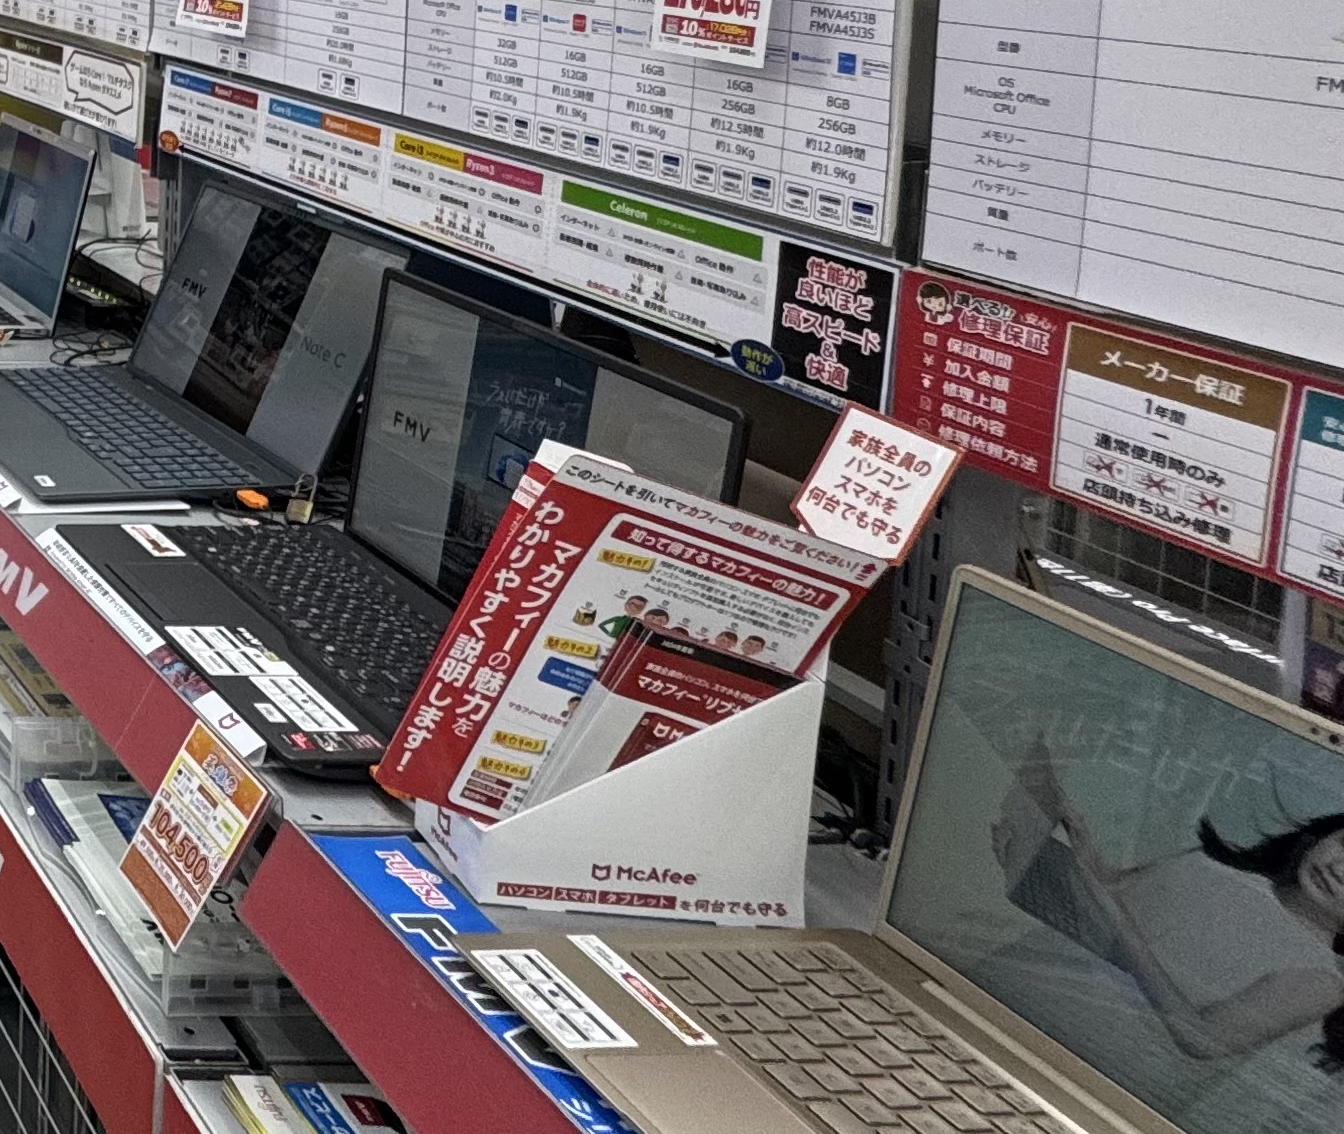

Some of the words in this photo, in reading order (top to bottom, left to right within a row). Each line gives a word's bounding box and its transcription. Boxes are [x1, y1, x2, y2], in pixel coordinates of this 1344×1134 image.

[726, 77, 754, 93] 16GB
[963, 85, 1009, 104] Microsoft
[1010, 91, 1052, 109] Office
[721, 98, 757, 114] 256GB
[826, 95, 851, 112] 8GB
[992, 102, 1018, 116] CPU
[817, 117, 858, 135] 256GB
[609, 199, 649, 222] Celeron
[180, 276, 208, 299] FMV
[808, 256, 865, 291] 性能が
[797, 279, 873, 321] 良いほど
[783, 304, 881, 354] 高スピード
[805, 355, 850, 392] 快適
[1099, 350, 1247, 407] メーカー保証
[392, 411, 432, 443] FMV
[845, 429, 933, 479] 家族全員の
[843, 454, 913, 492] パソコン
[833, 475, 900, 515] スマホを
[807, 485, 904, 546] 何台でも守る
[374, 848, 457, 912] FUJITSU
[615, 865, 699, 888] McAfee
[500, 883, 551, 900] パソコン
[556, 887, 597, 904] スマホ
[604, 891, 673, 908] タブレット
